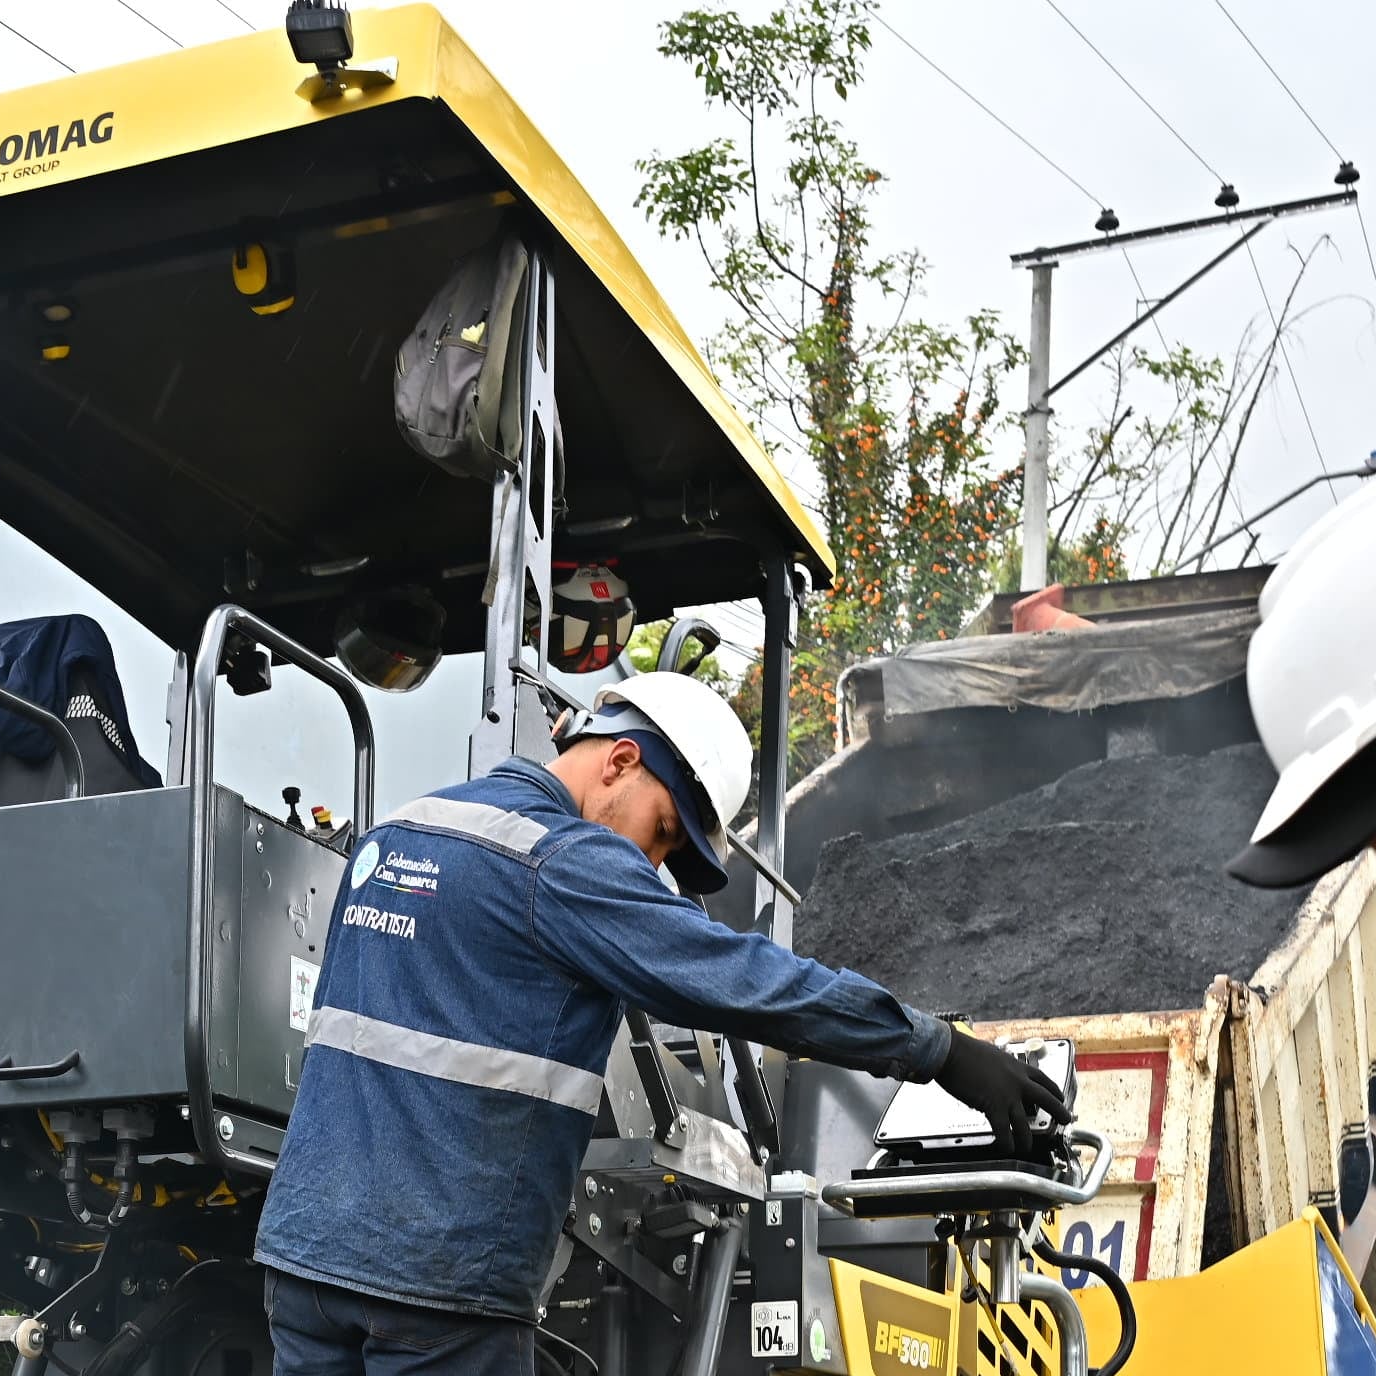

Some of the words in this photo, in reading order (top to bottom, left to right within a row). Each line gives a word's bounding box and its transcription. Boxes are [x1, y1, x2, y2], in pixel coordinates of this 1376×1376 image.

[13, 160, 61, 180] GROUP
[342, 904, 416, 940] CONTRATISTA
[1026, 1220, 1125, 1290] 01
[755, 1325, 783, 1352] 104
